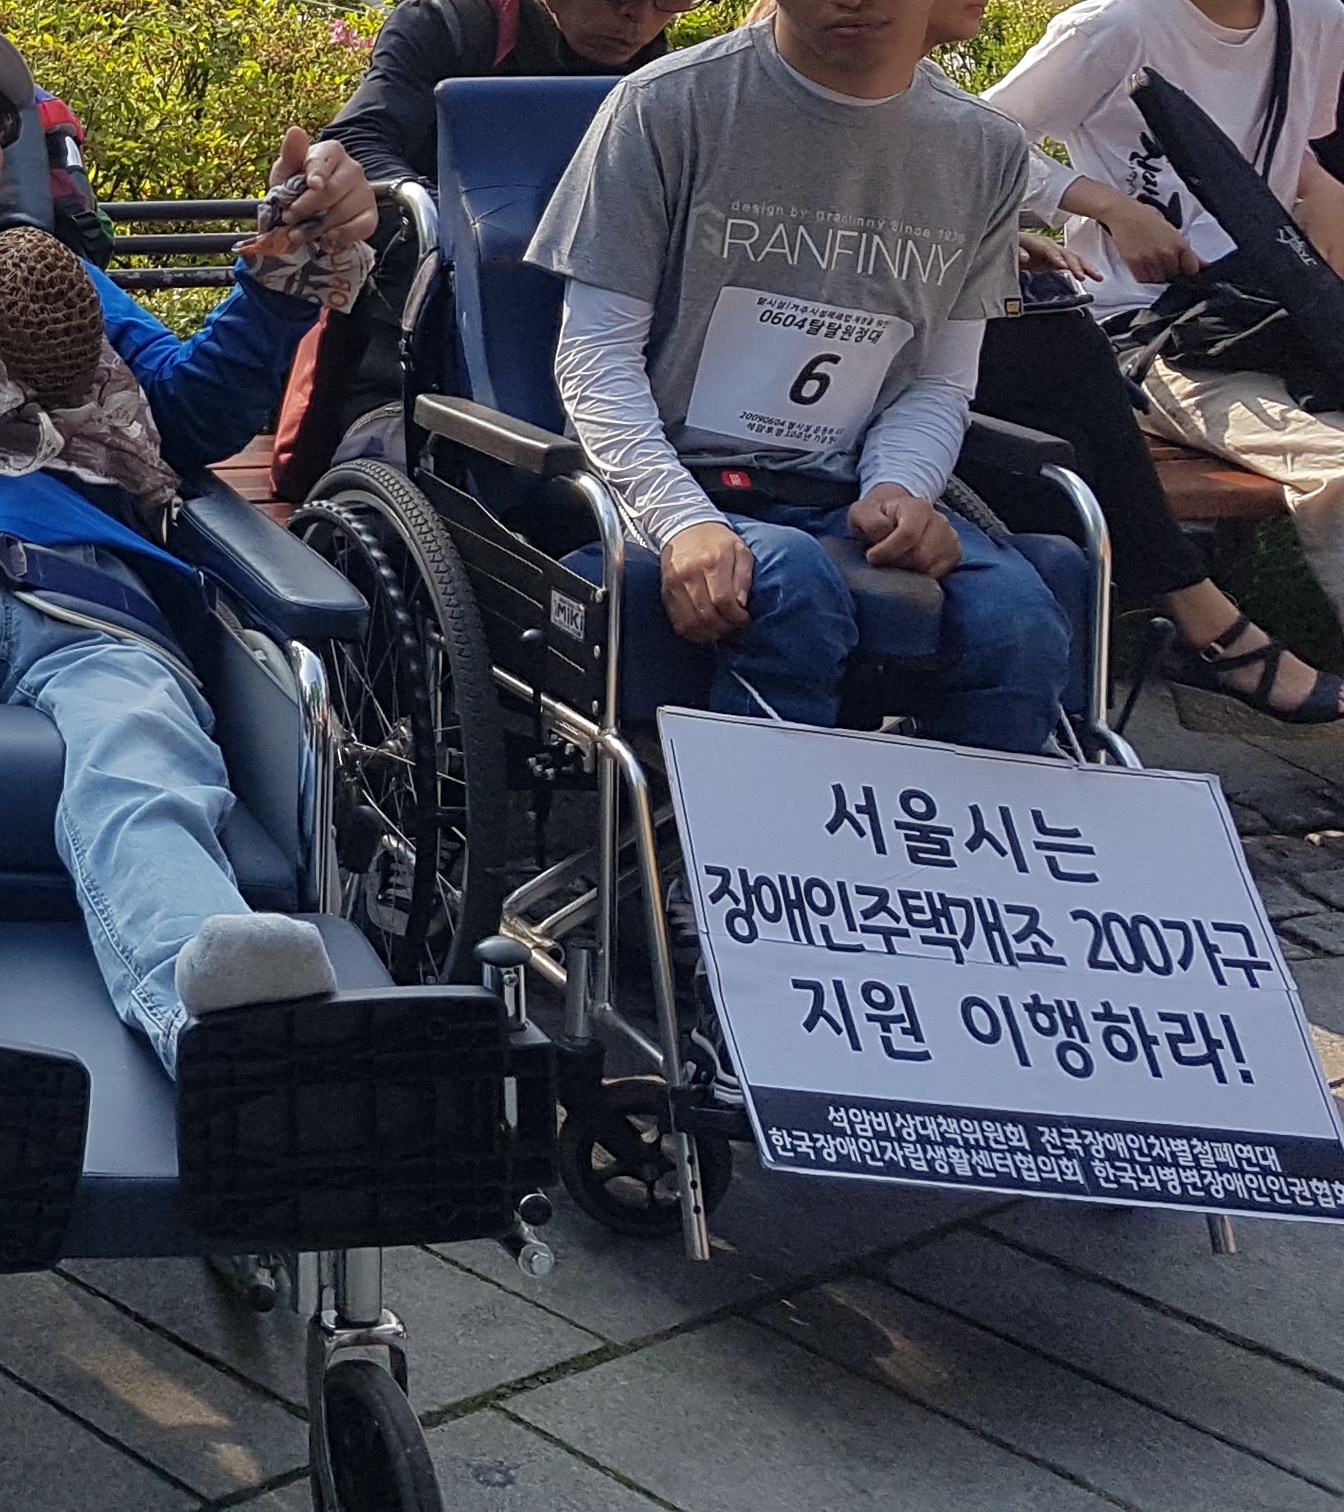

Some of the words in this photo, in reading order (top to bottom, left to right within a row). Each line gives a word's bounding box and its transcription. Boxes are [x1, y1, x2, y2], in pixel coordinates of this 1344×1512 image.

[732, 200, 784, 218] design
[788, 352, 843, 406] 6
[824, 782, 1100, 883] 서울시는
[704, 864, 1067, 967] 장애인주택개조
[1070, 907, 1272, 989] 200가구
[791, 976, 932, 1062] 지원
[960, 992, 1255, 1085] 이행하라!
[768, 1126, 1085, 1184] 한국장애인자립생활센터협의회
[827, 1105, 1031, 1151] 석암비상대책위원회
[1037, 1125, 1283, 1173] 전국장애인차별철폐연대
